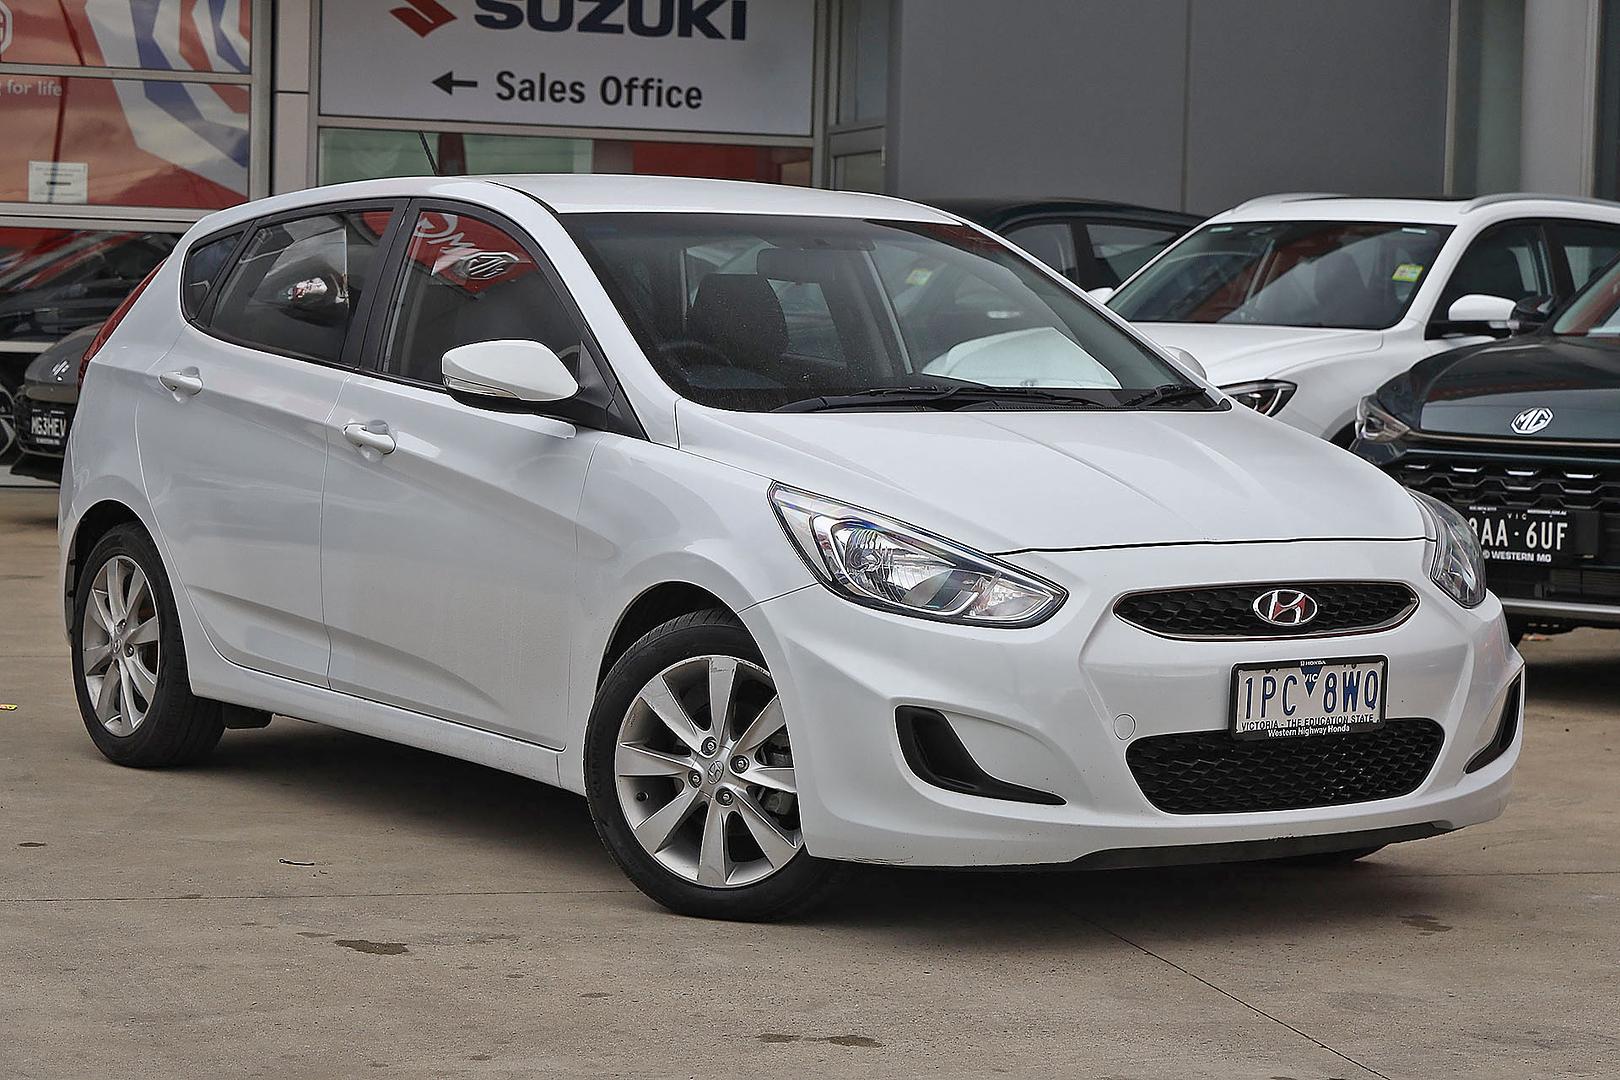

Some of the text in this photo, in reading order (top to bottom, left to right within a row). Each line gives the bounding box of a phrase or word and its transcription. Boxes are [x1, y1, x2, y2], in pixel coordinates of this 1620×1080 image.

[473, 0, 747, 41] SUZUKI
[7, 80, 32, 96] for
[37, 79, 63, 97] life
[495, 70, 702, 109] Sales Office
[1511, 406, 1554, 434] MG
[1506, 512, 1527, 521] VIC
[1491, 550, 1535, 562] WESTERN
[1302, 673, 1318, 683] VIC
[1241, 719, 1279, 732] VICTORIA
[1287, 718, 1302, 729] THE
[1304, 715, 1349, 727] EDUCATION
[1350, 713, 1374, 724] STATE
[1268, 723, 1350, 737] Western Highway Honda
